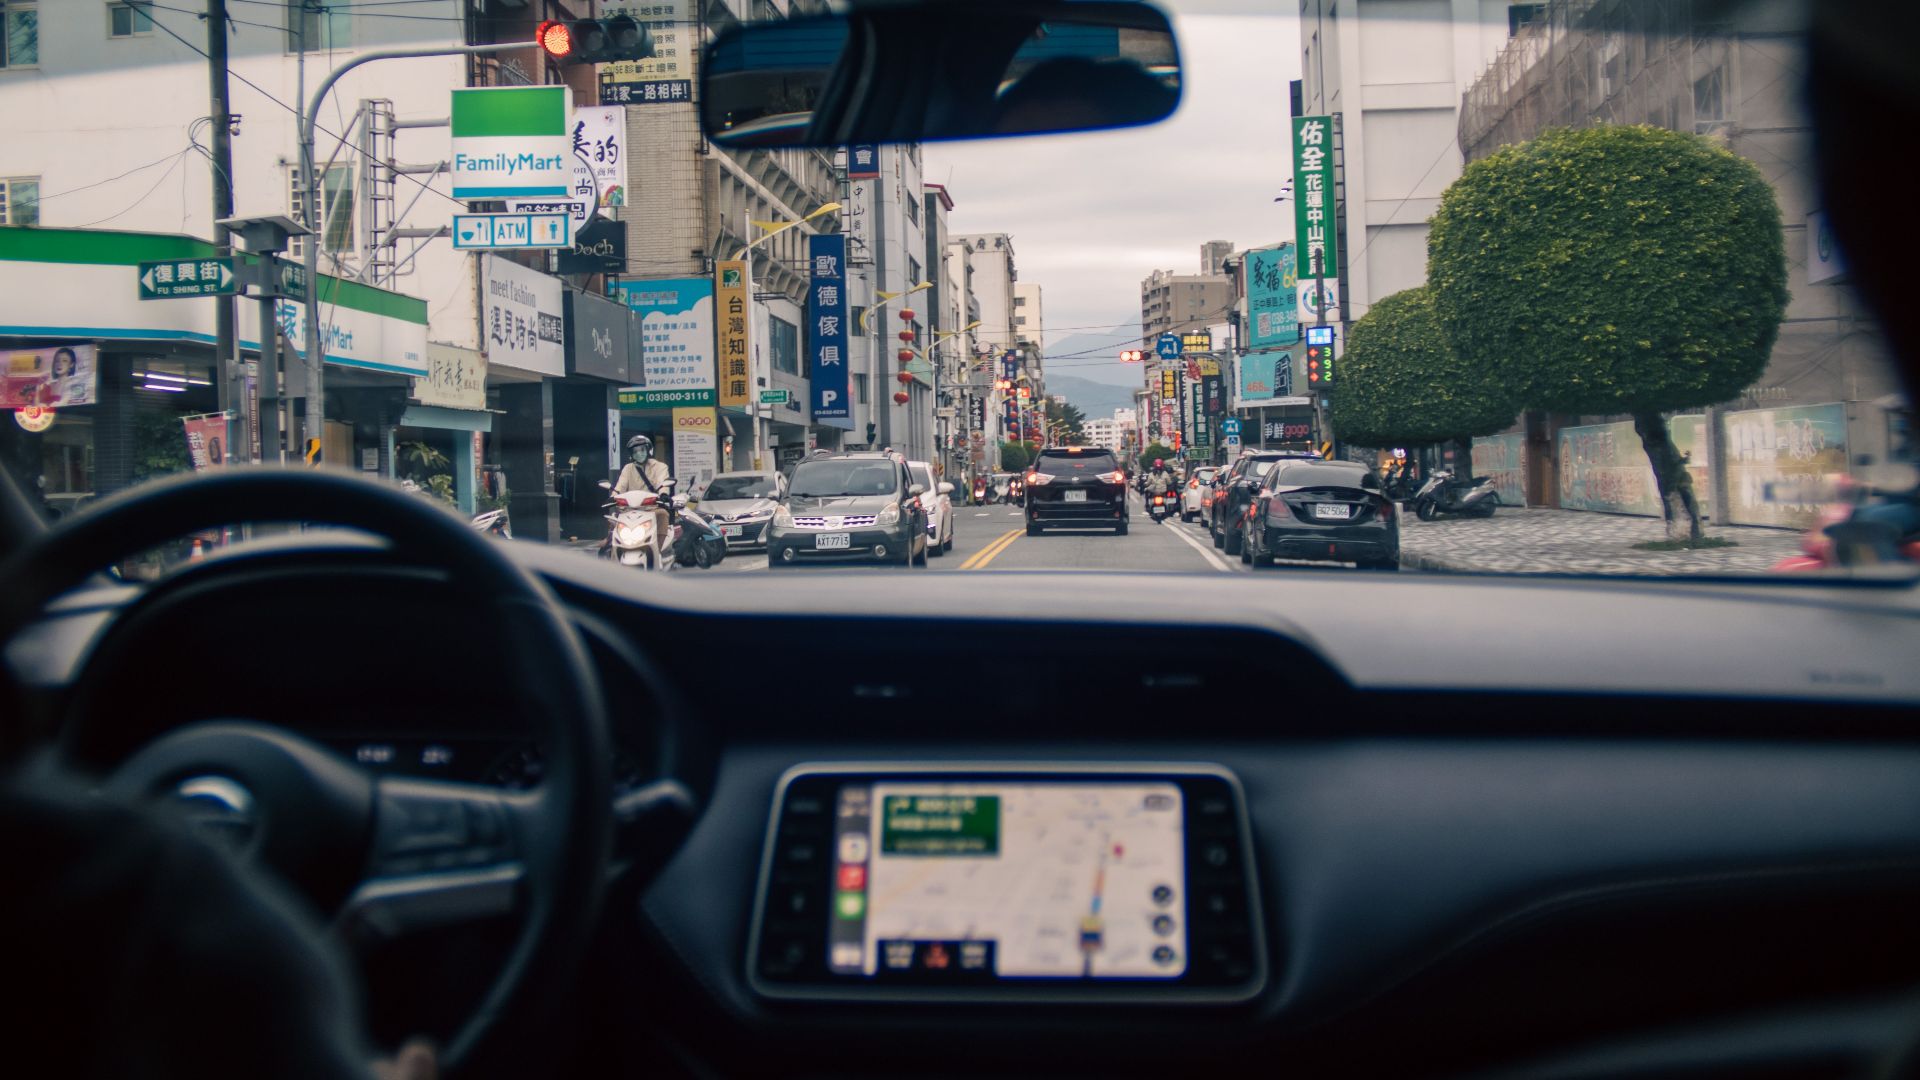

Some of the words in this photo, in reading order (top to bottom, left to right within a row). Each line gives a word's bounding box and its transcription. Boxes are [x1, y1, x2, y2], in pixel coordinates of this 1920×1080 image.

[455, 152, 563, 175] FamilyMart
[497, 222, 526, 239] ATM
[155, 261, 220, 283] 復興街
[172, 285, 200, 294] SHING
[204, 284, 217, 292] ST.
[491, 279, 509, 299] meet
[510, 280, 536, 308] fashion
[816, 254, 840, 367] 歐德傢俱
[728, 295, 746, 398] 台灣知識庫
[645, 392, 709, 403] (03)800-3116
[822, 390, 838, 408] P
